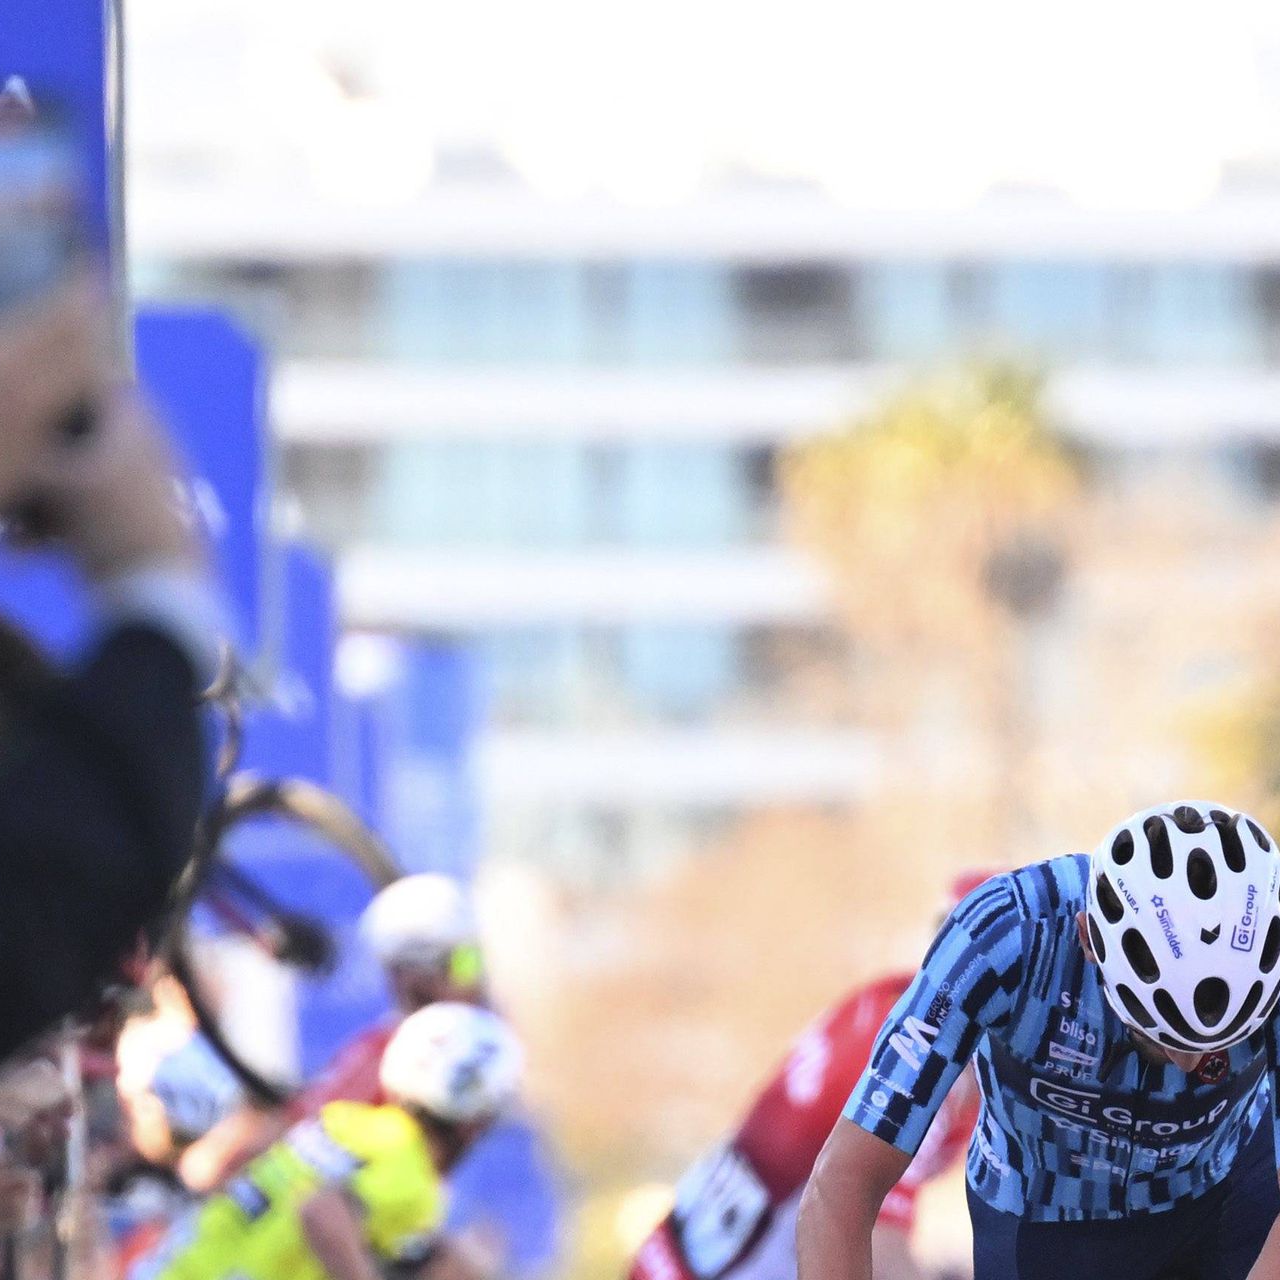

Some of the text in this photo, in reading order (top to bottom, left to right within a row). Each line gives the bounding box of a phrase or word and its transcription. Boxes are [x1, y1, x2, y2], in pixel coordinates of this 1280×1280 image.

[1241, 884, 1258, 926] Group
[1156, 908, 1184, 960] Simoldes
[1237, 926, 1251, 946] Gi
[1047, 1092, 1228, 1136] Gi Group
